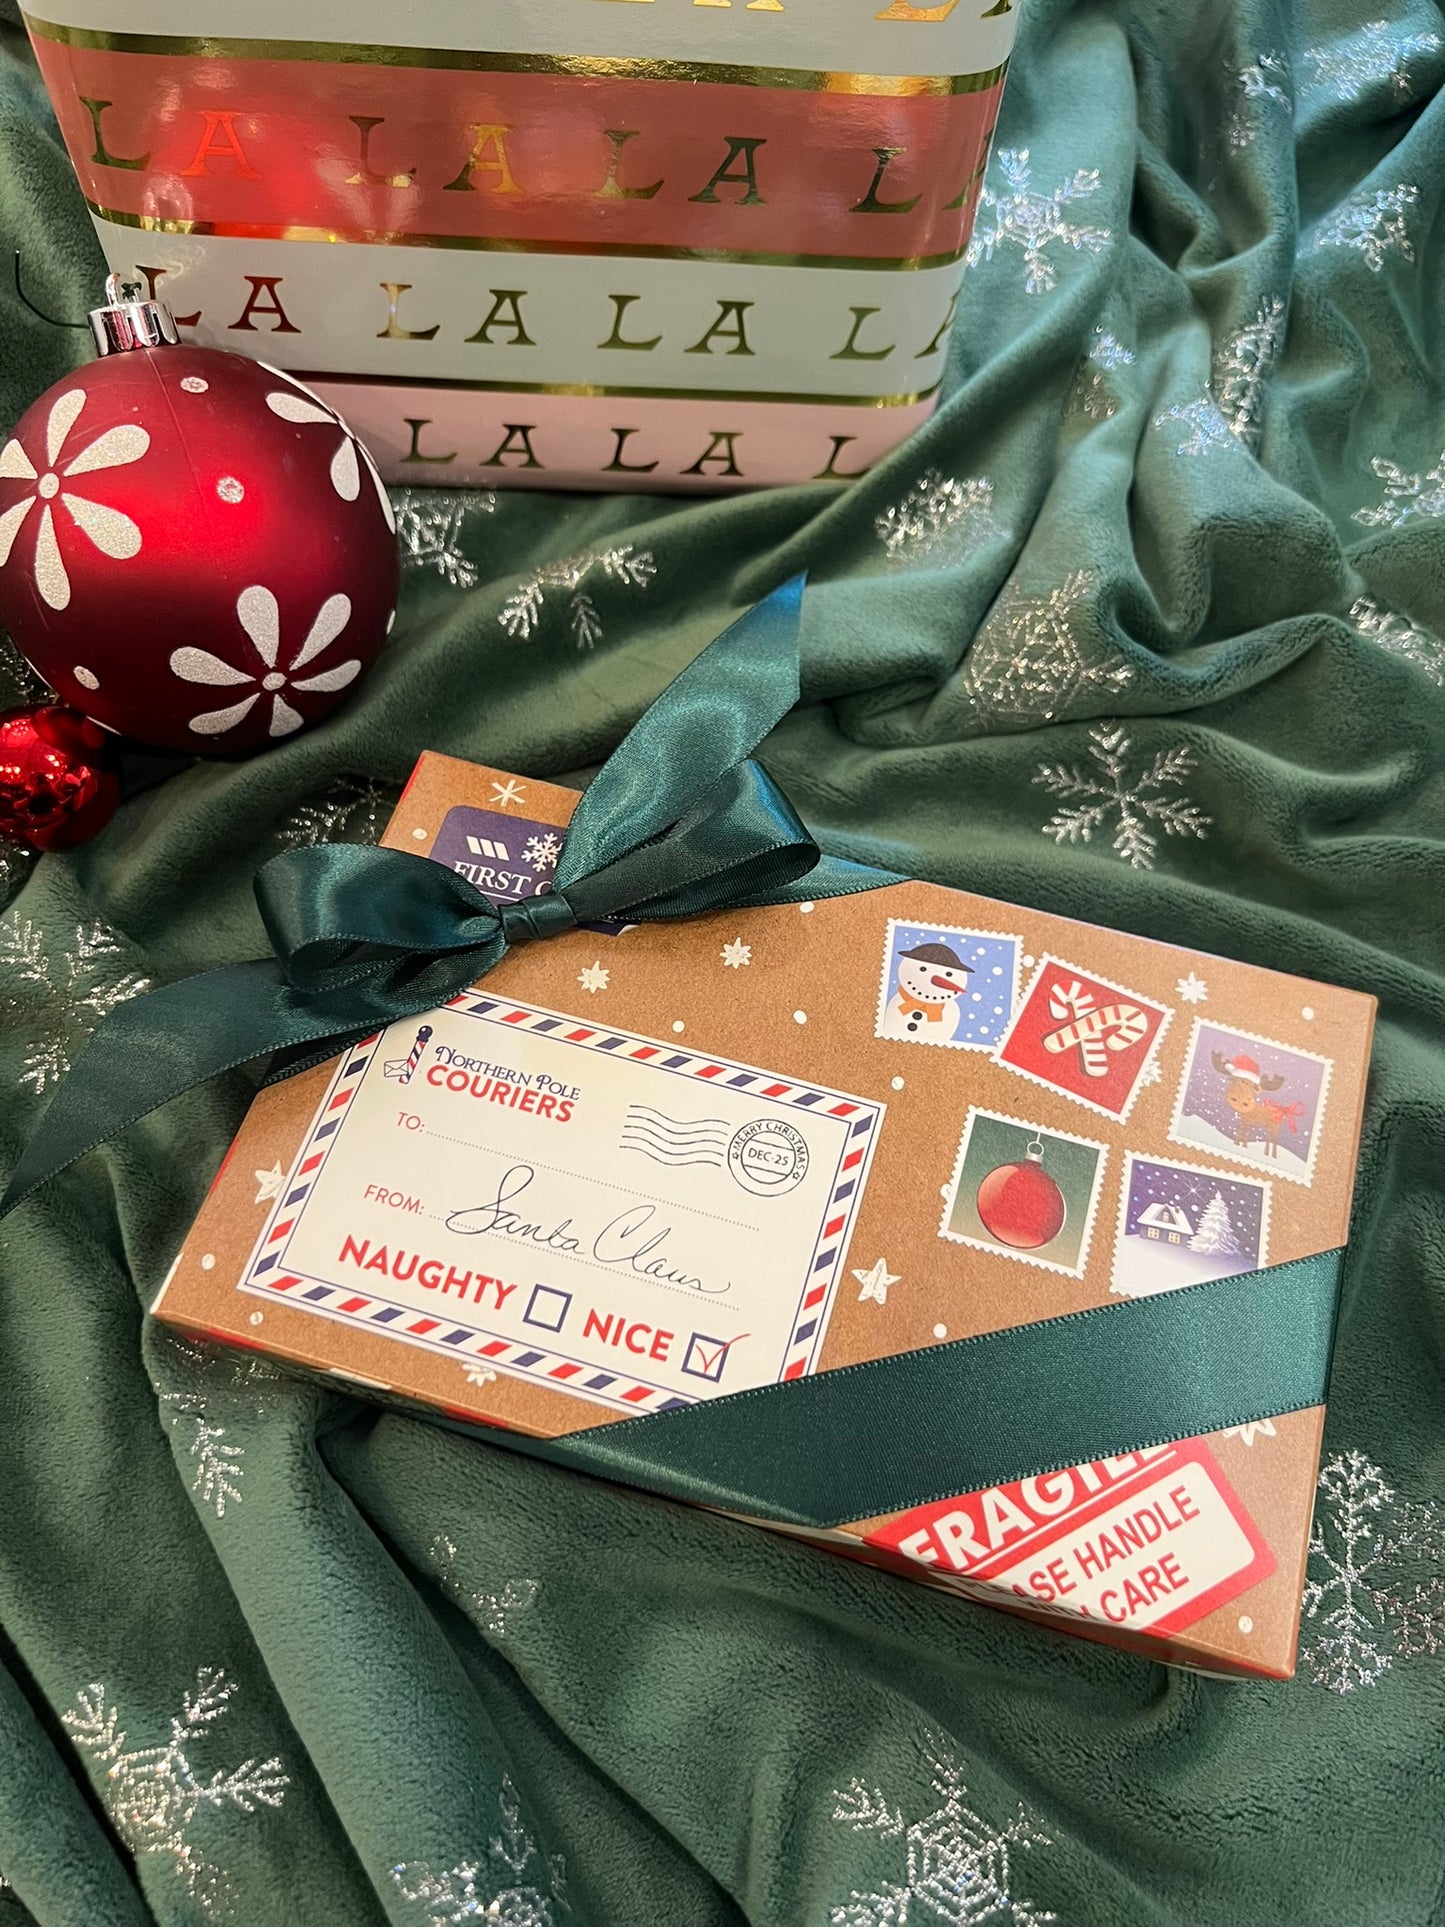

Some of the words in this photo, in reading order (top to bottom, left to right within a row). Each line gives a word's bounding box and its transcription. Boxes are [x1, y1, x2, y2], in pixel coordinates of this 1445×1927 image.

[78, 97, 262, 179] LA
[344, 116, 524, 195] LA
[594, 130, 767, 206] LA
[376, 282, 537, 346] LA
[597, 295, 756, 356] LA
[400, 418, 546, 469] LA
[601, 428, 746, 477] LA
[453, 860, 532, 895] FIRST
[426, 1064, 575, 1123] COURIERS
[536, 1074, 581, 1101] POLE
[396, 1111, 425, 1133] TO:
[732, 1122, 763, 1151] MERRY
[765, 1122, 806, 1170] CHRISTMAS
[363, 1184, 425, 1216] FROM:
[445, 1165, 585, 1255] Santa
[593, 1204, 731, 1294] Claus
[338, 1234, 518, 1311] NAUGHTY
[581, 1308, 675, 1362] NICE
[1073, 1485, 1201, 1580] HANDLE
[1099, 1552, 1190, 1623] CARE
